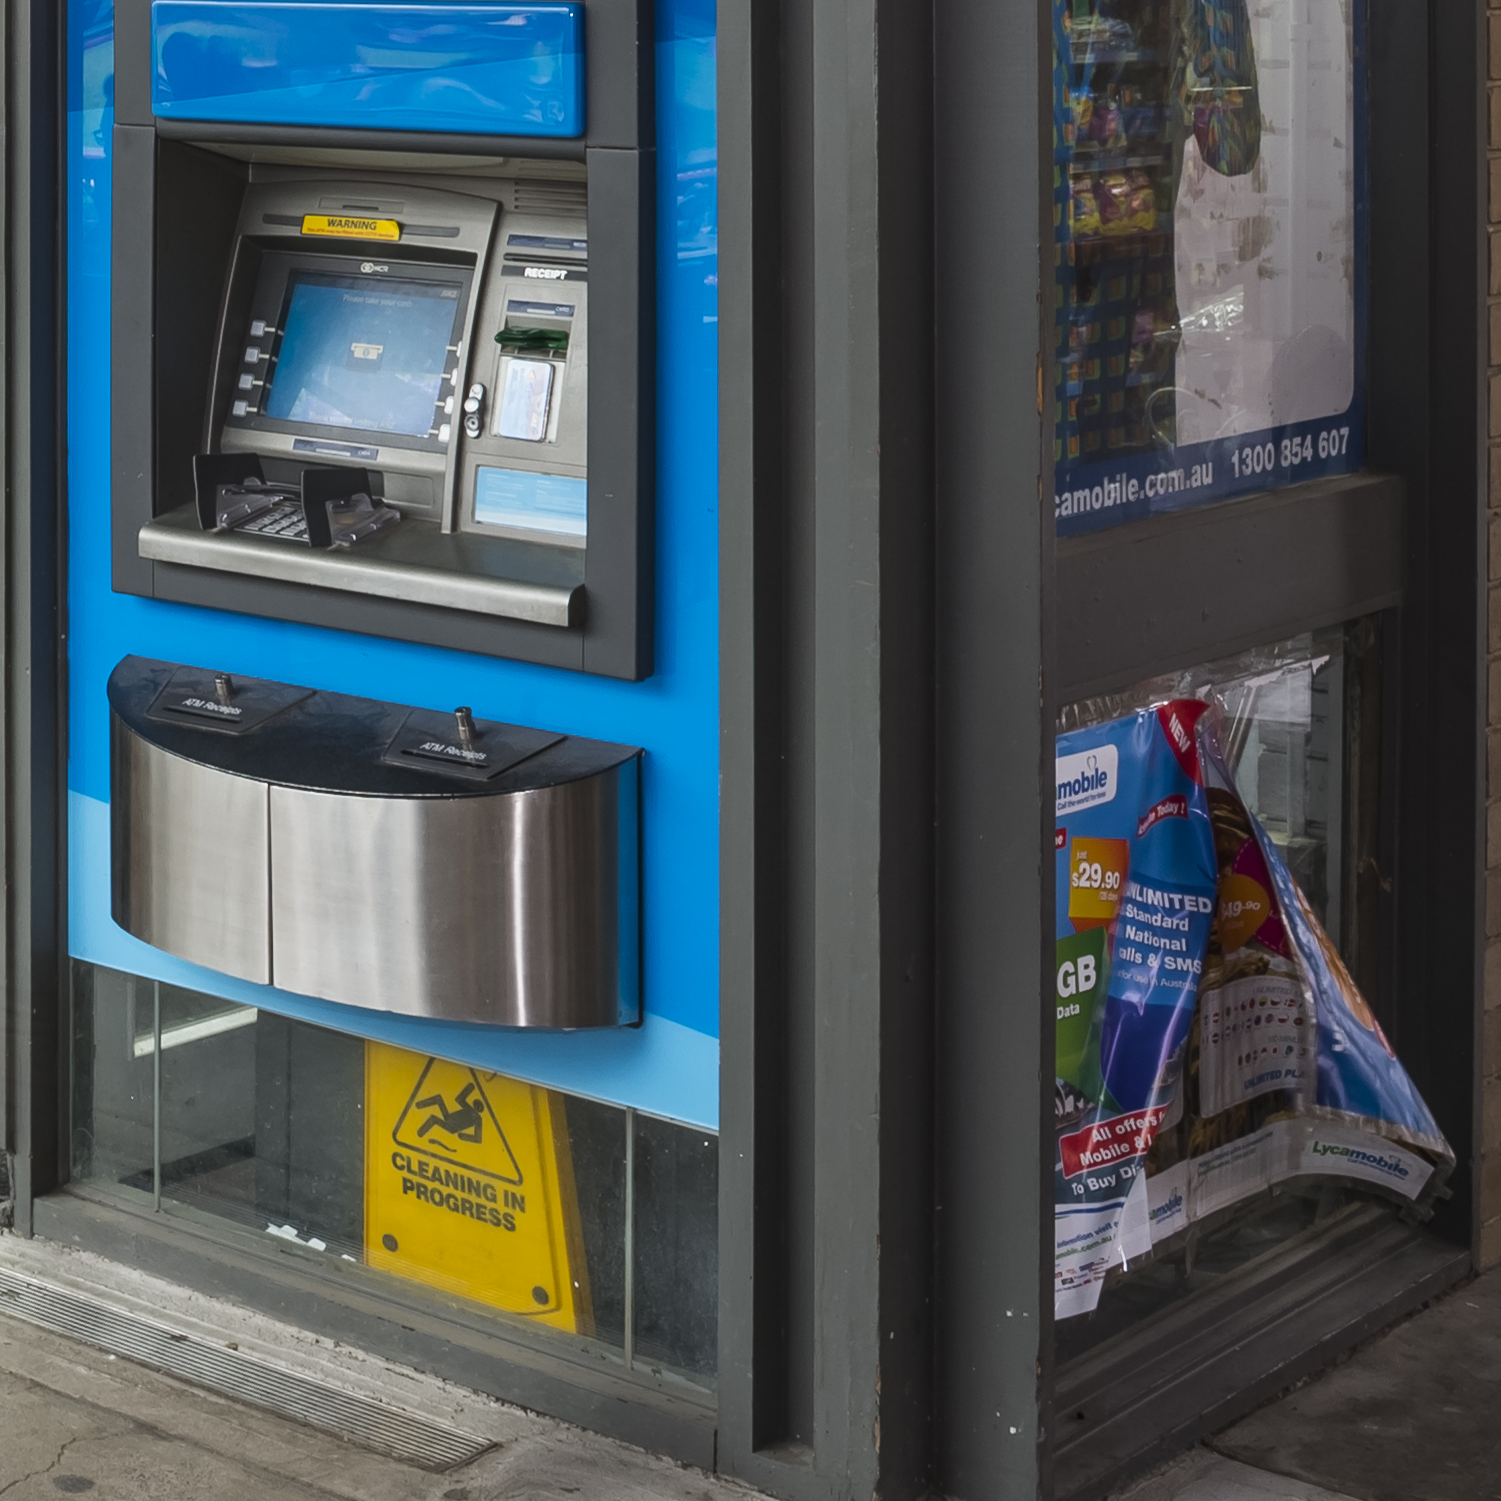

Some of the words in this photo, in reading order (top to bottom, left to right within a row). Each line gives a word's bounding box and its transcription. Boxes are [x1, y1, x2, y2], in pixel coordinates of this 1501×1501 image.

[327, 218, 378, 230] WARNING
[524, 267, 568, 280] RECEIPT
[1231, 444, 1275, 481] 1300
[1280, 435, 1314, 467] 854
[1317, 427, 1351, 458] 607
[1169, 713, 1191, 753] NEW
[1071, 862, 1121, 889] $29.90
[1125, 904, 1189, 932] Standard
[1125, 925, 1187, 952] National
[1164, 957, 1202, 975] SMS
[1057, 1003, 1080, 1020] Data
[1091, 1127, 1112, 1144] All
[1115, 1114, 1158, 1136] offers
[1079, 1142, 1130, 1167] Mobile
[1312, 1140, 1410, 1181] Lycamobile
[391, 1151, 498, 1203] CLEANING
[503, 1189, 526, 1215] IN
[1087, 1172, 1117, 1193] Buy
[402, 1176, 517, 1233] PROGRESS
